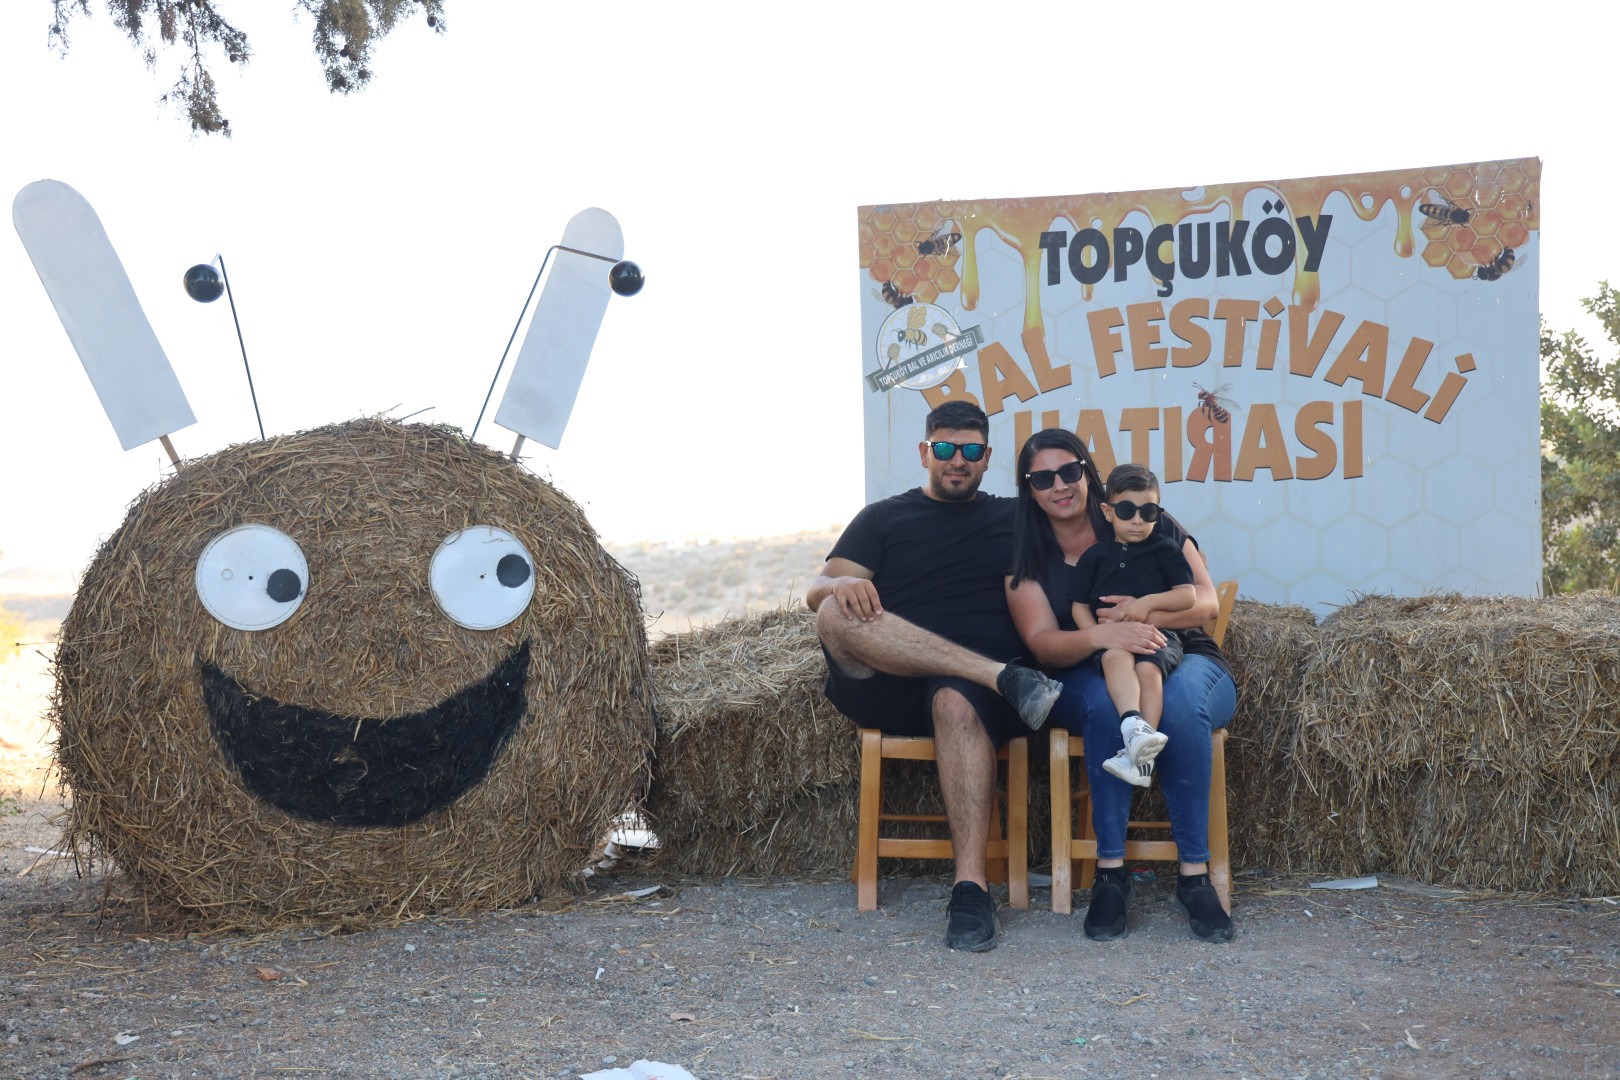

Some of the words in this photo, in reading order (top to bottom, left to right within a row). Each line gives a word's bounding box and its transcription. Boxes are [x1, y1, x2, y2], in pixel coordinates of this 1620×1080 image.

[1039, 200, 1334, 297] TOPÇUKÖY
[878, 365, 908, 387] TOPÇUKÖY
[907, 360, 919, 373] BAL
[918, 356, 927, 367] VE
